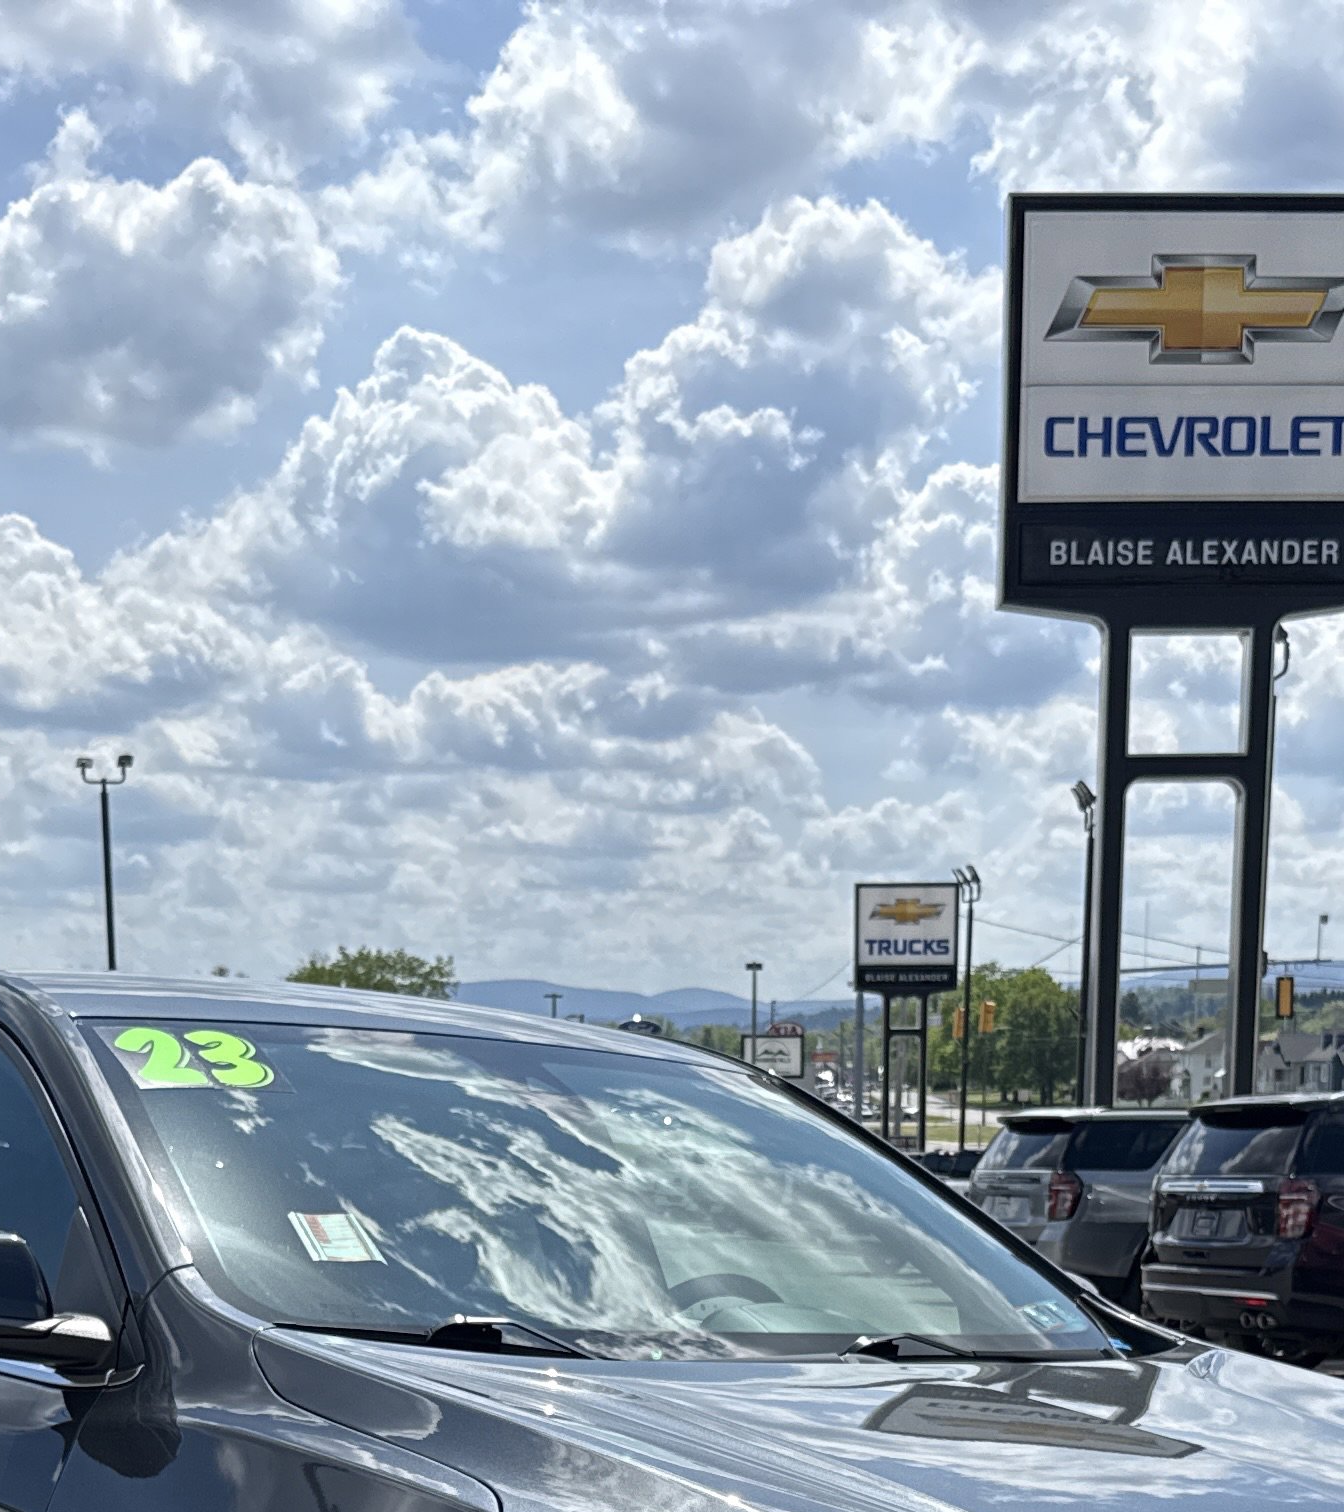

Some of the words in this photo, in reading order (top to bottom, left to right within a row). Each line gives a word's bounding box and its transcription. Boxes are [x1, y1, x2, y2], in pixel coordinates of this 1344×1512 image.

[1049, 539, 1155, 566] BLAISE
[1164, 538, 1340, 565] ALEXANDER
[864, 938, 950, 956] TRUCKS
[113, 1027, 275, 1088] 23
